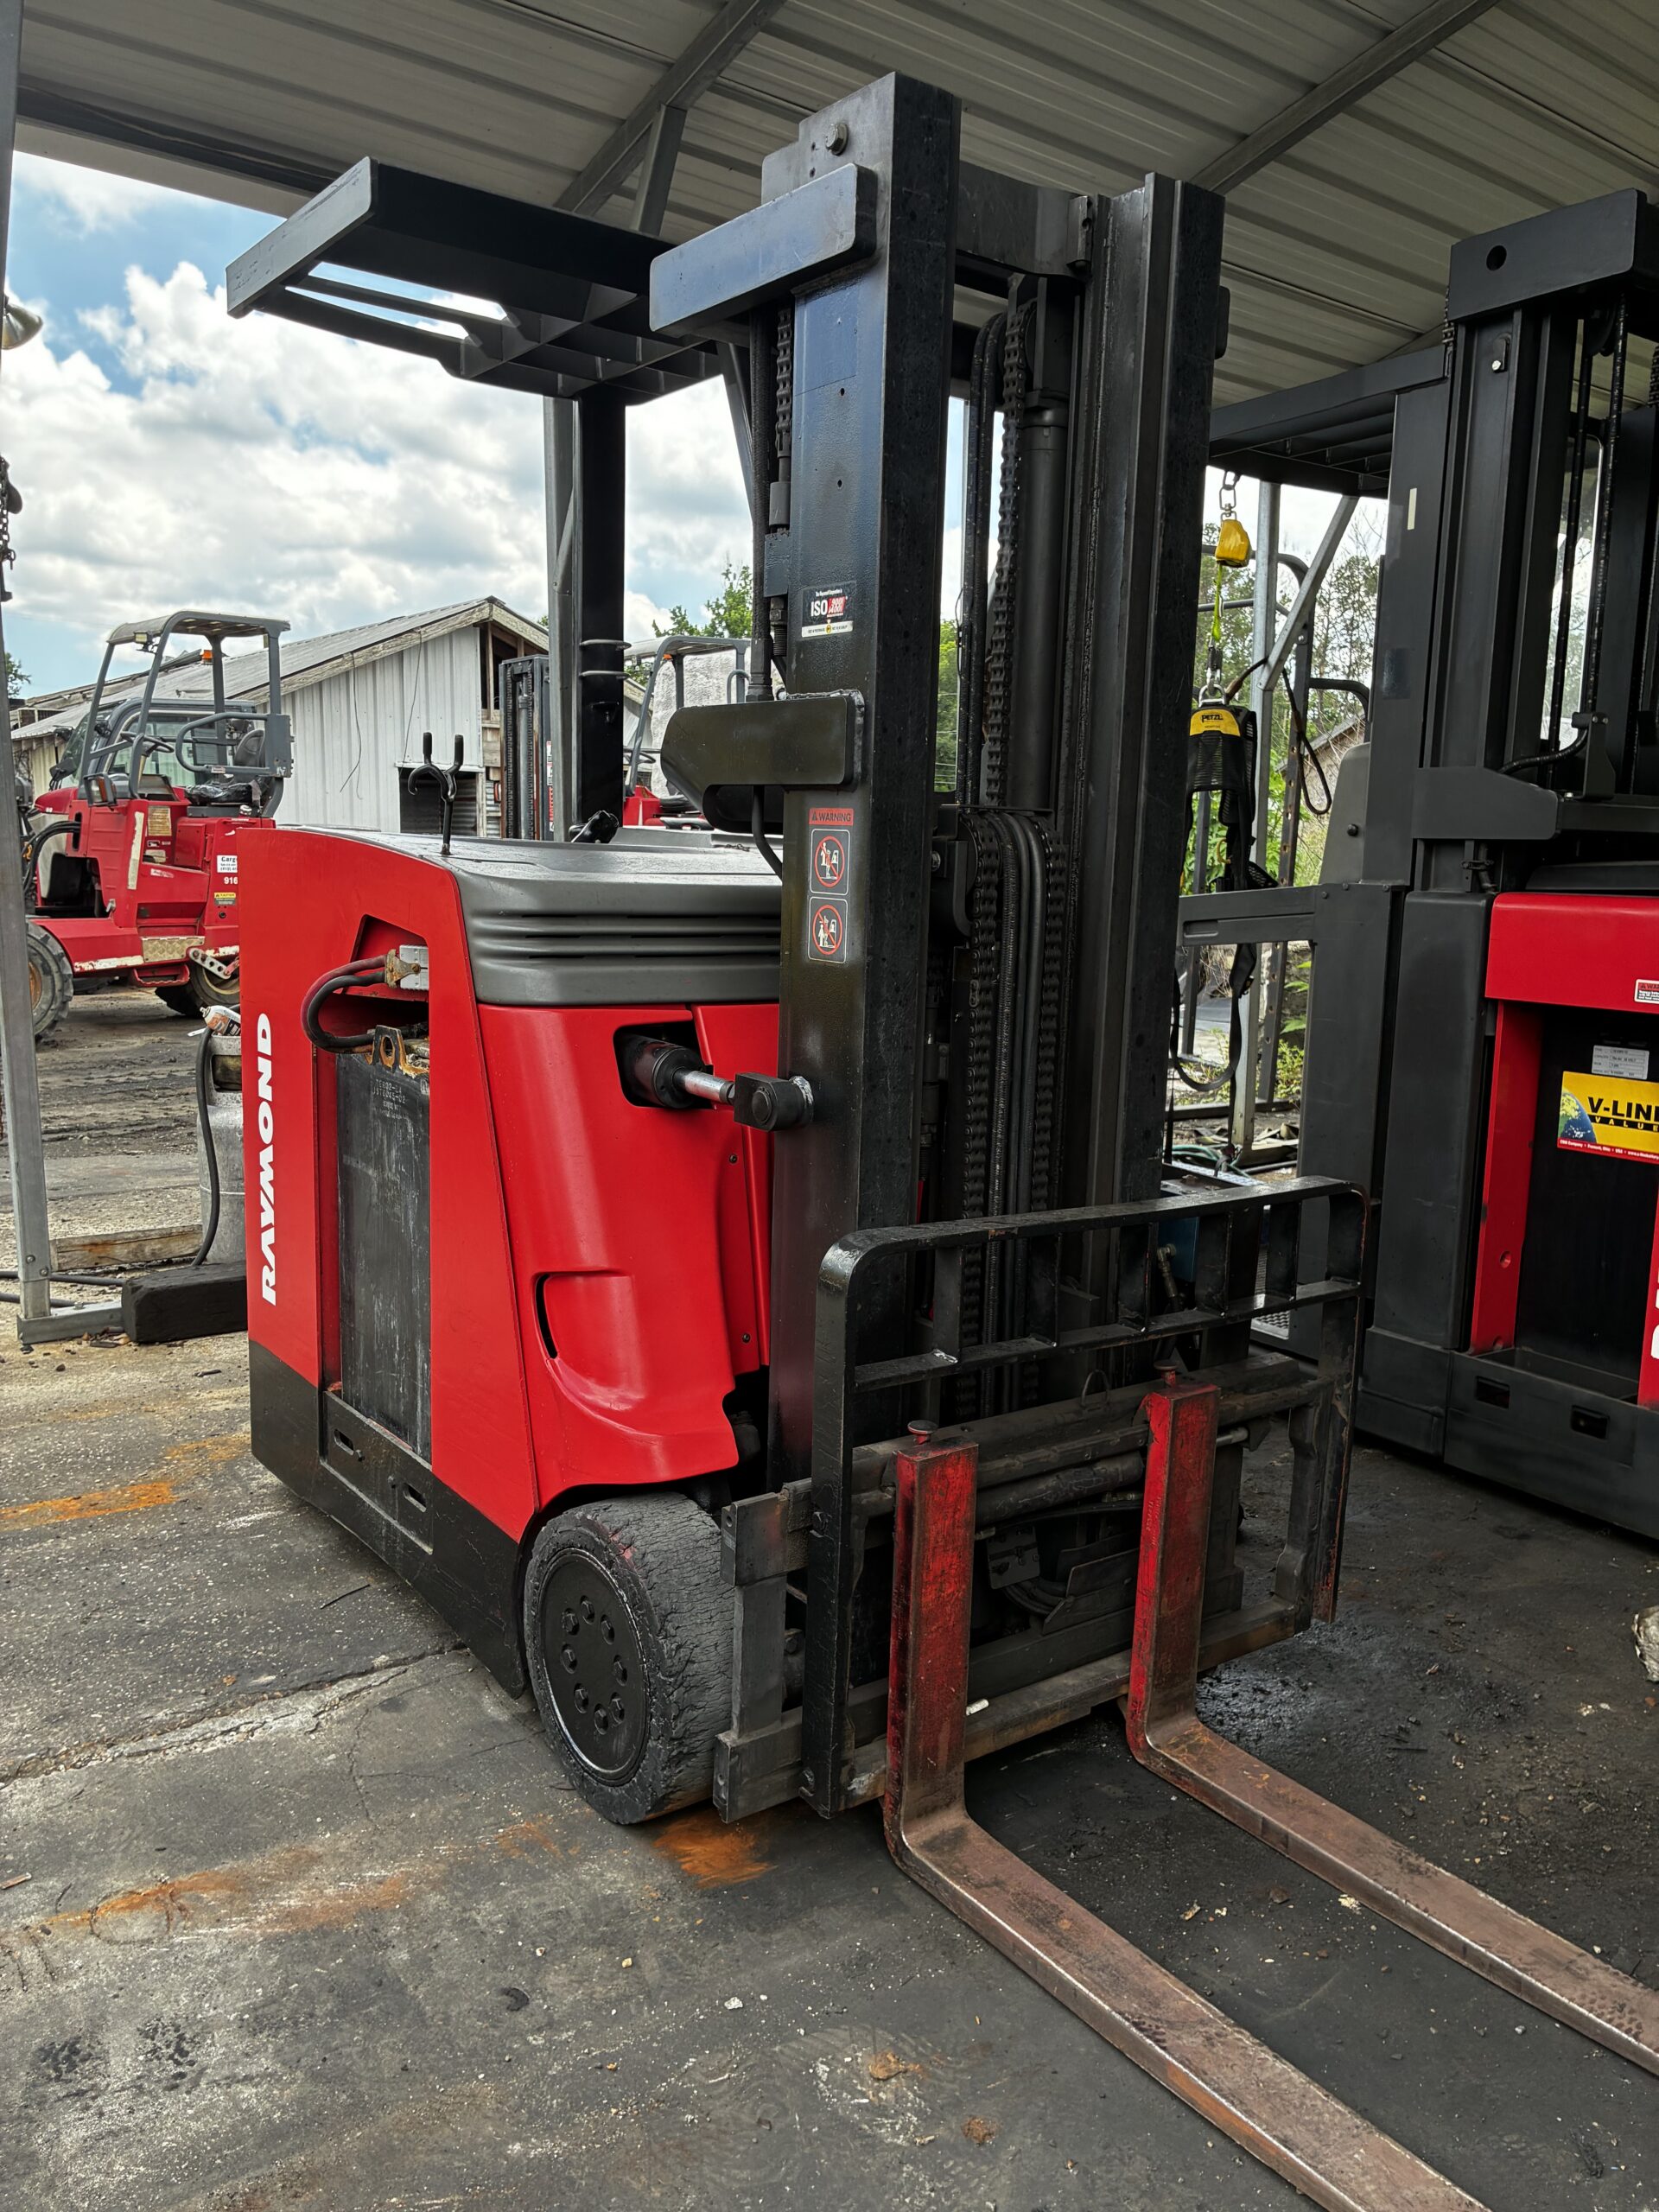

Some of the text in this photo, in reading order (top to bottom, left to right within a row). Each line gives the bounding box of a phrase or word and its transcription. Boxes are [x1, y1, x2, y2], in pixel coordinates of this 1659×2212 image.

[810, 600, 828, 616] ISO
[1201, 714, 1224, 724] PETZL
[818, 812, 851, 822] WARNING
[1595, 1116, 1658, 1132] VALUE
[257, 1013, 276, 1307] RAYMOND
